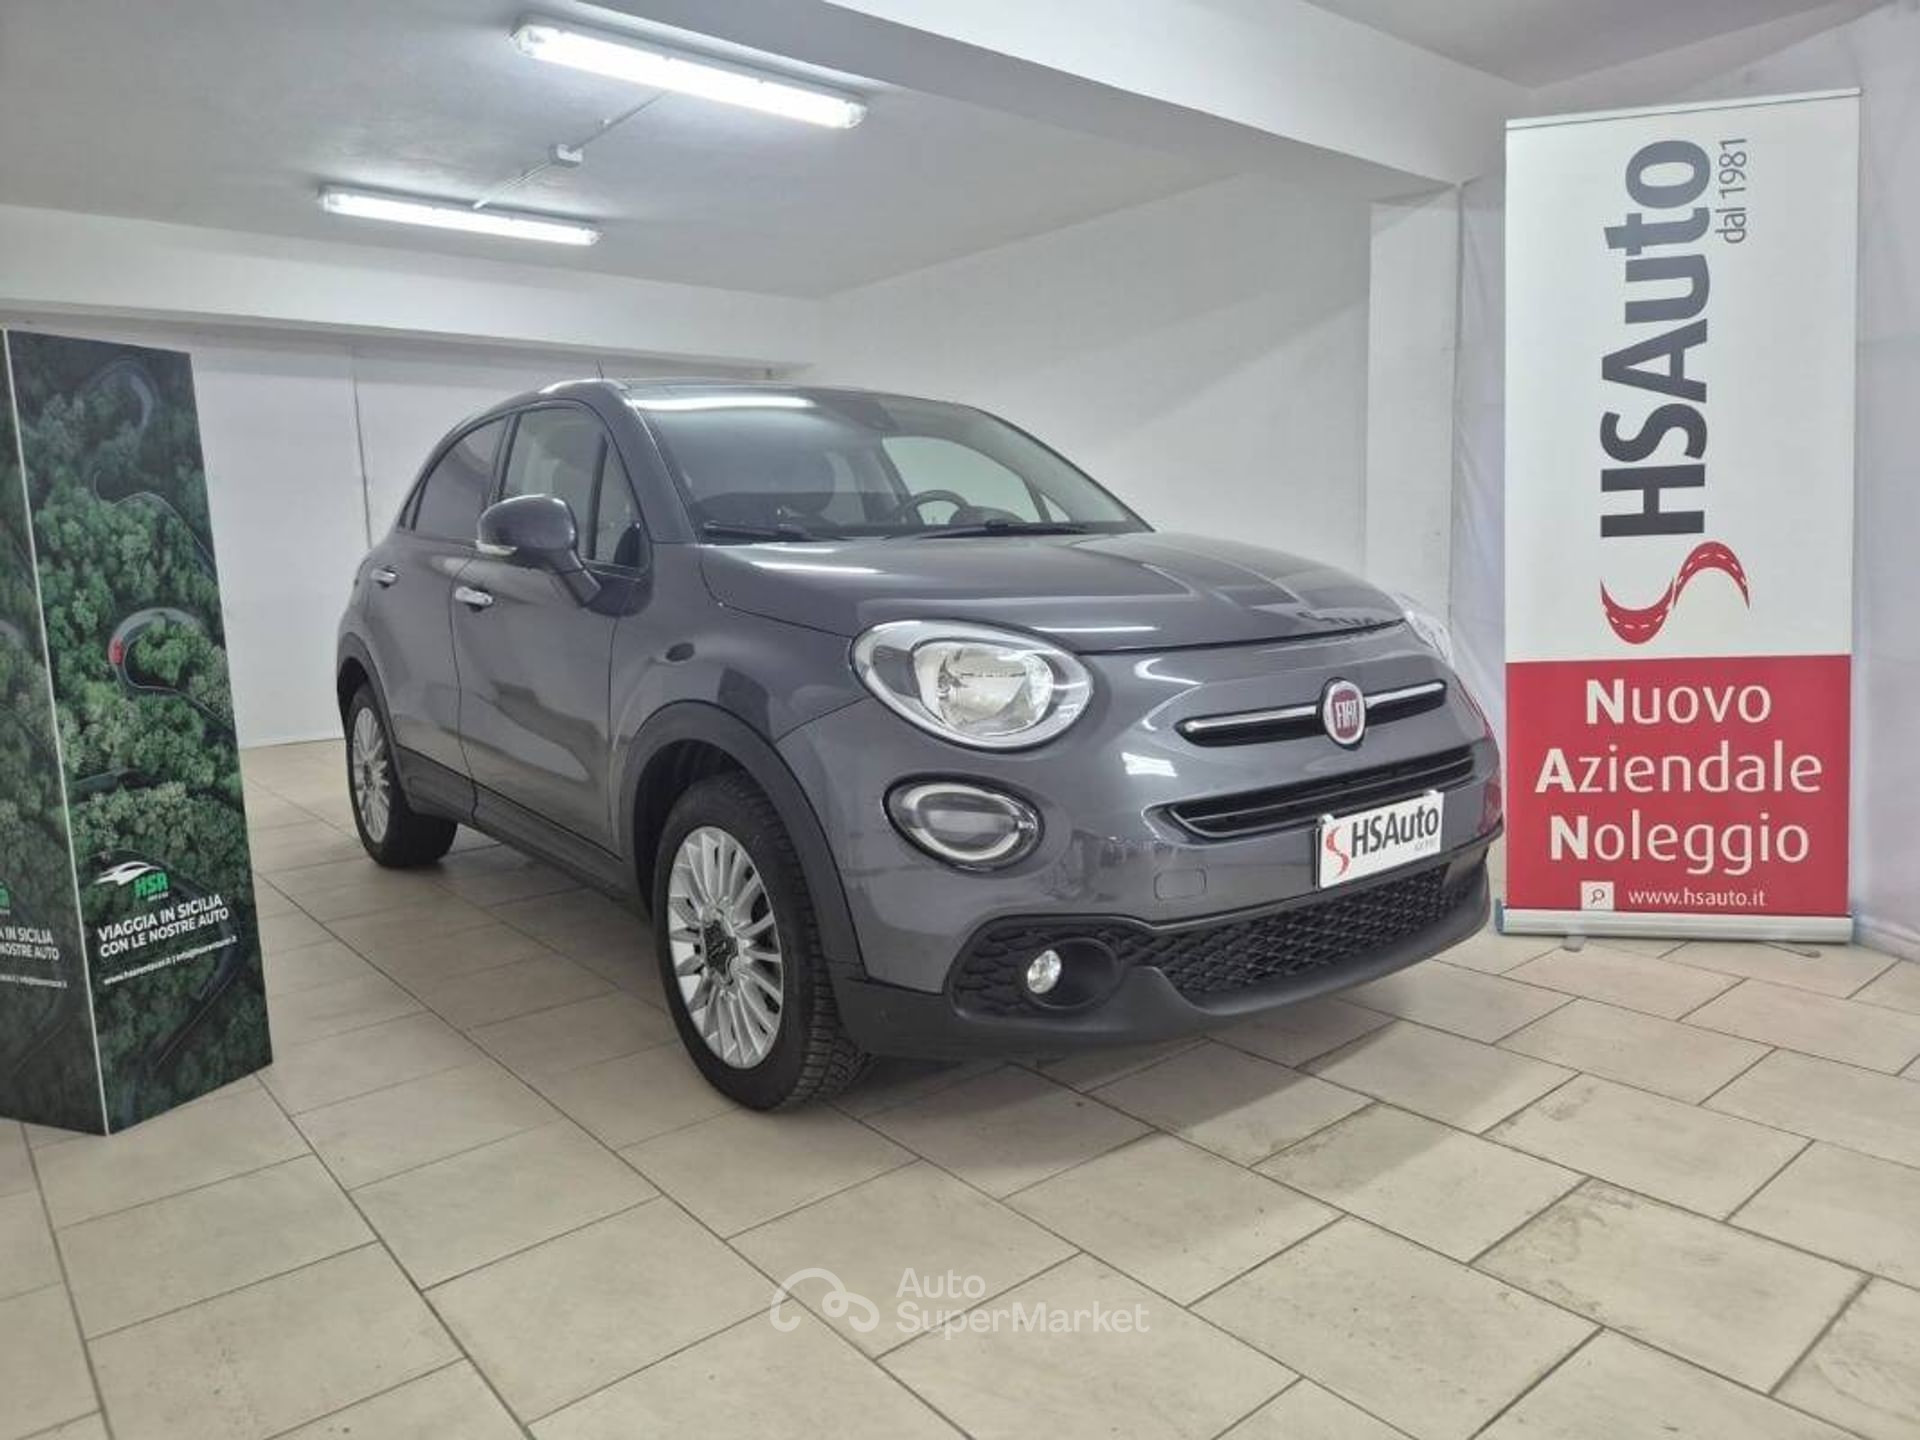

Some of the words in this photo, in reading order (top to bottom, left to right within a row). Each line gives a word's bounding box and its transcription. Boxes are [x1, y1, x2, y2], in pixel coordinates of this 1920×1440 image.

[1718, 137, 1747, 198] 1981
[1715, 207, 1747, 244] dal
[1600, 139, 1712, 538] HSAuto
[1335, 700, 1358, 729] FIAT
[1586, 678, 1771, 725] Nuovo
[1534, 739, 1823, 793] Aziendale
[1351, 804, 1440, 858] HSAuto
[1550, 808, 1810, 877] Noleggio
[97, 912, 159, 942] VIAGGIA
[160, 906, 176, 924] IN
[176, 893, 223, 920] SICILIA
[1628, 887, 1766, 907] www.hsauto.it
[99, 937, 129, 958] CON
[131, 932, 147, 949] LE
[148, 916, 196, 942] NOSTRE
[197, 906, 229, 928] AUTO
